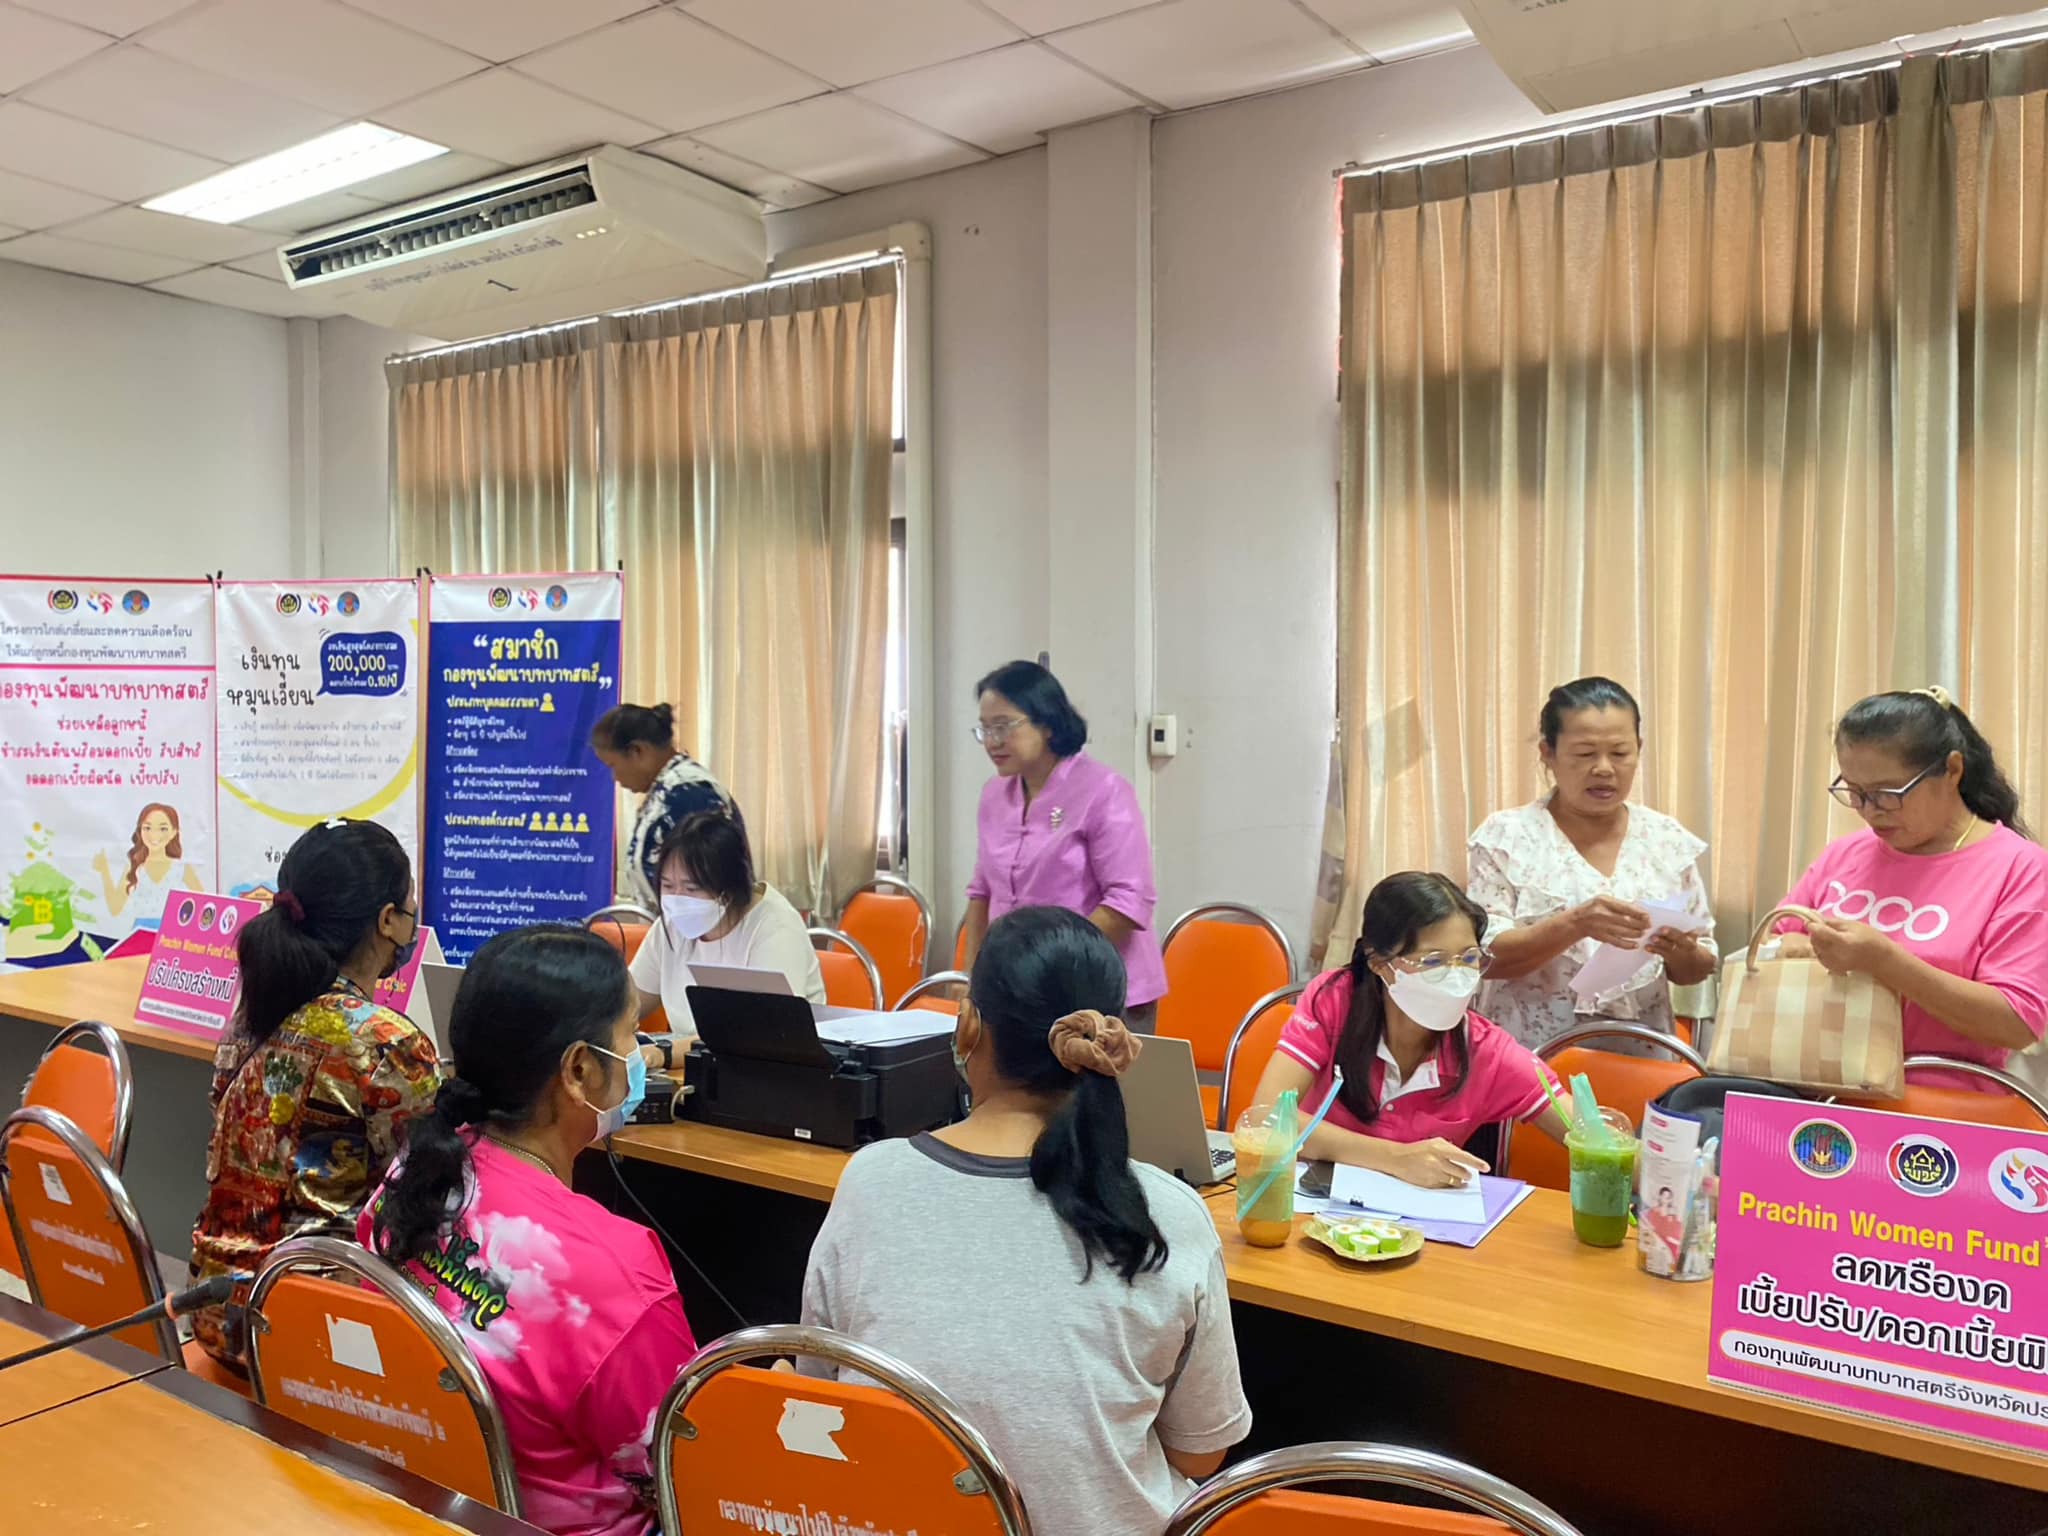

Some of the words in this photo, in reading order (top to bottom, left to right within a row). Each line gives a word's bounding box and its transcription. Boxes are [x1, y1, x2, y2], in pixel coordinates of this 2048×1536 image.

[241, 646, 300, 680] เงินทุน
[328, 655, 386, 677] 200,000
[0, 676, 209, 708] องทุนพัฒนาบทบาทสตรี
[226, 683, 315, 715] หมุนเวียน
[58, 709, 147, 736] ช่วยเหลือลูกหนี้
[1738, 1192, 1838, 1232] Prachin
[1850, 1210, 1954, 1252] Women
[1836, 1254, 2009, 1310] ลดหรืองด
